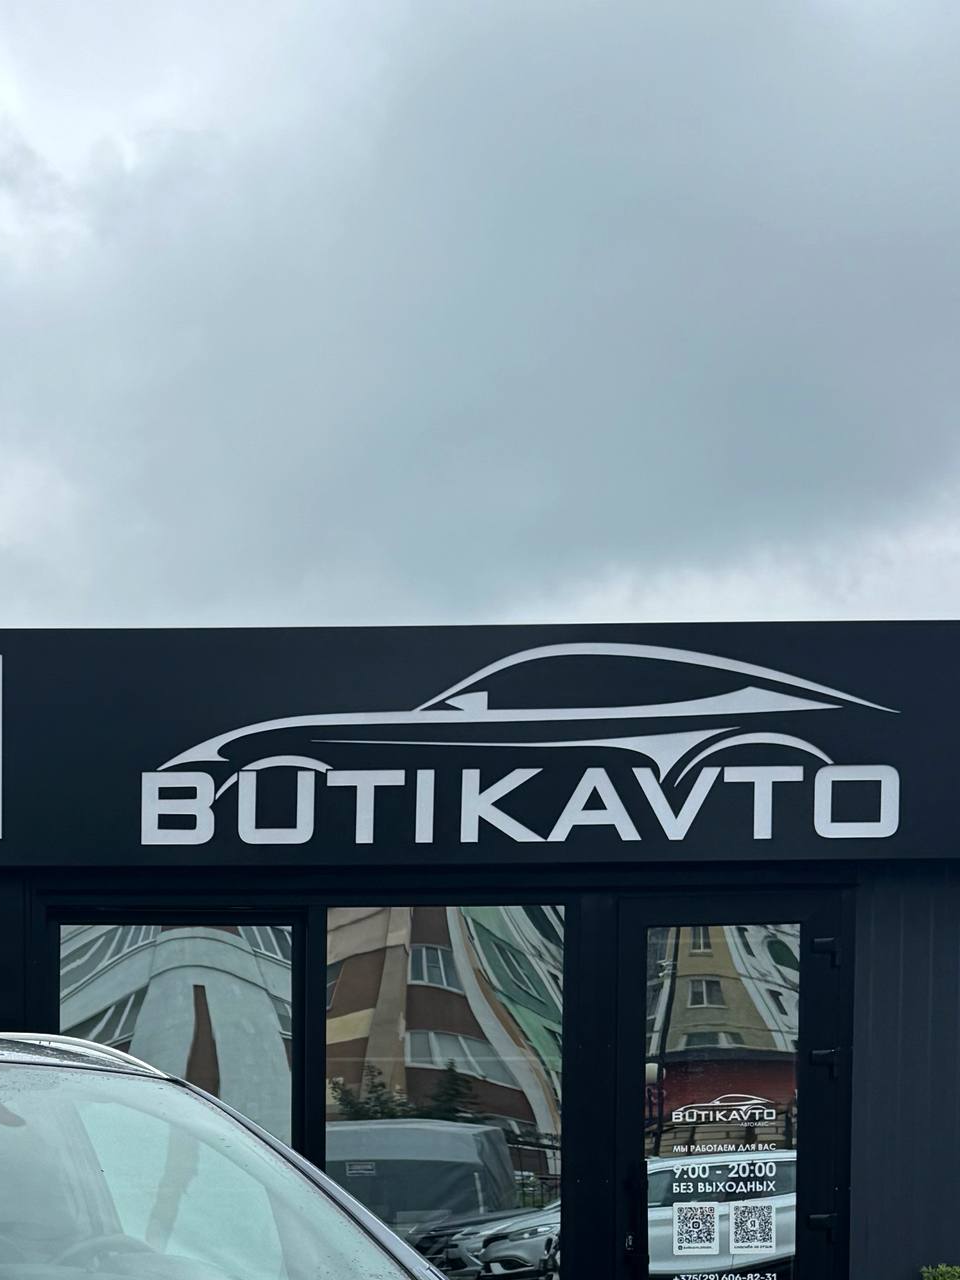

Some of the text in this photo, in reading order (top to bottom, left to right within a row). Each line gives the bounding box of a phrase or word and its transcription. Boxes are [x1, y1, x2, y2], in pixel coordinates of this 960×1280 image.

[140, 764, 901, 846] BUTIKAVTO
[672, 1109, 776, 1122] BUTIKAVTO
[690, 1144, 735, 1152] РАБОТАЕМ
[738, 1144, 756, 1152] ДЛЯ
[758, 1143, 777, 1151] ВАС
[672, 1164, 709, 1179] 9:00
[728, 1162, 777, 1178] 20:00
[672, 1181, 776, 1193] БЕЗ ВЫХОДНЫХ
